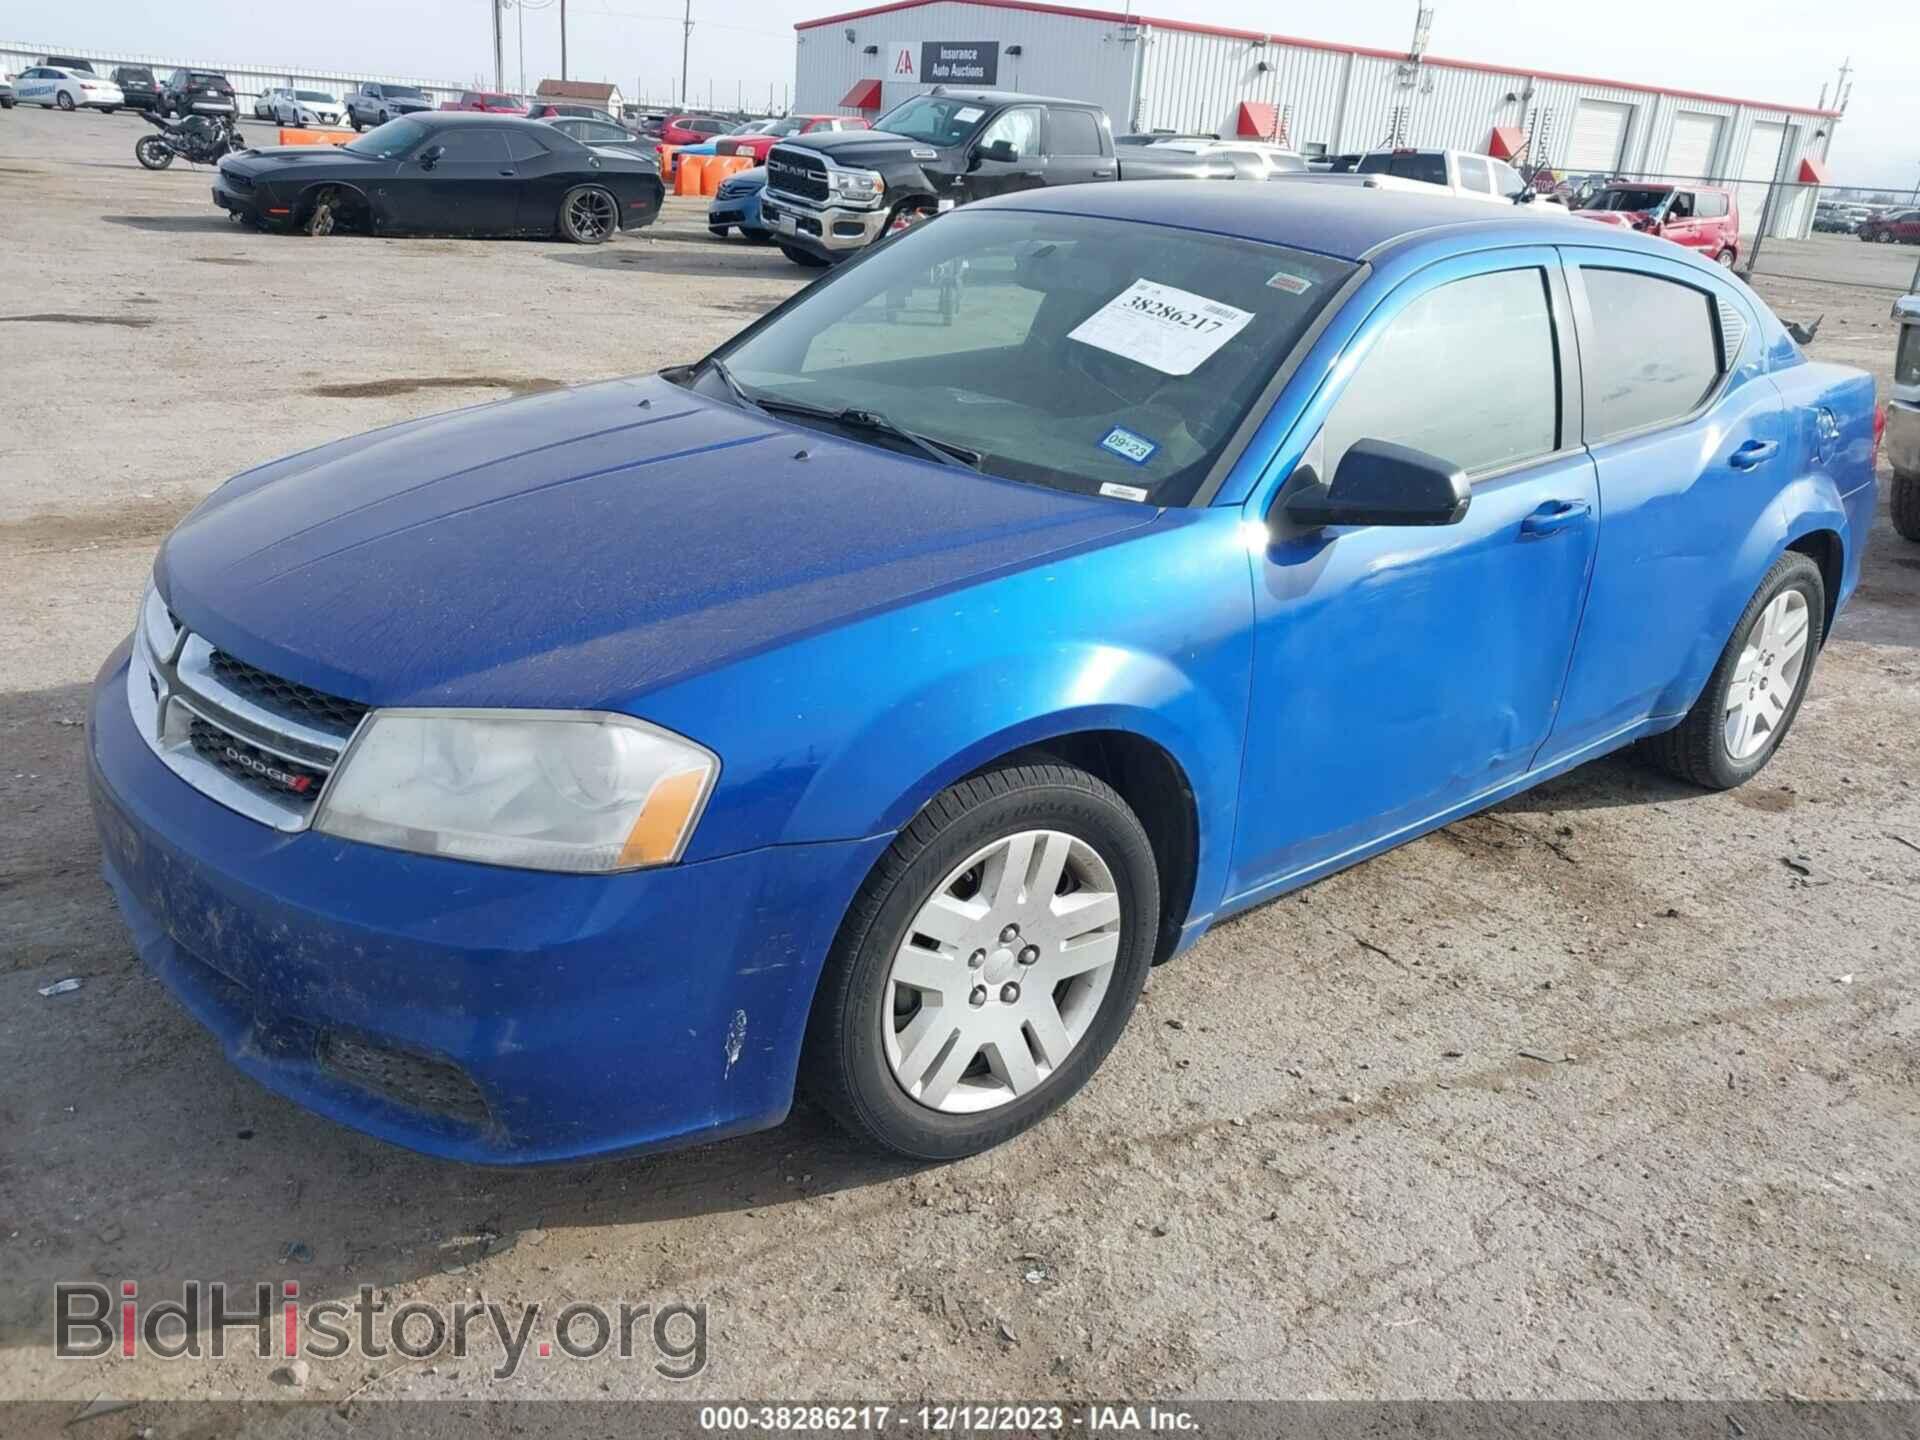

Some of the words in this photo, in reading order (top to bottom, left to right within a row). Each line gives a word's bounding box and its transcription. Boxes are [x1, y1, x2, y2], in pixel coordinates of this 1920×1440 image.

[941, 46, 978, 60] Insurance
[932, 63, 950, 76] Auto
[951, 63, 985, 77] Auctions
[1122, 296, 1224, 334] 38286217
[226, 747, 298, 787] DODGE
